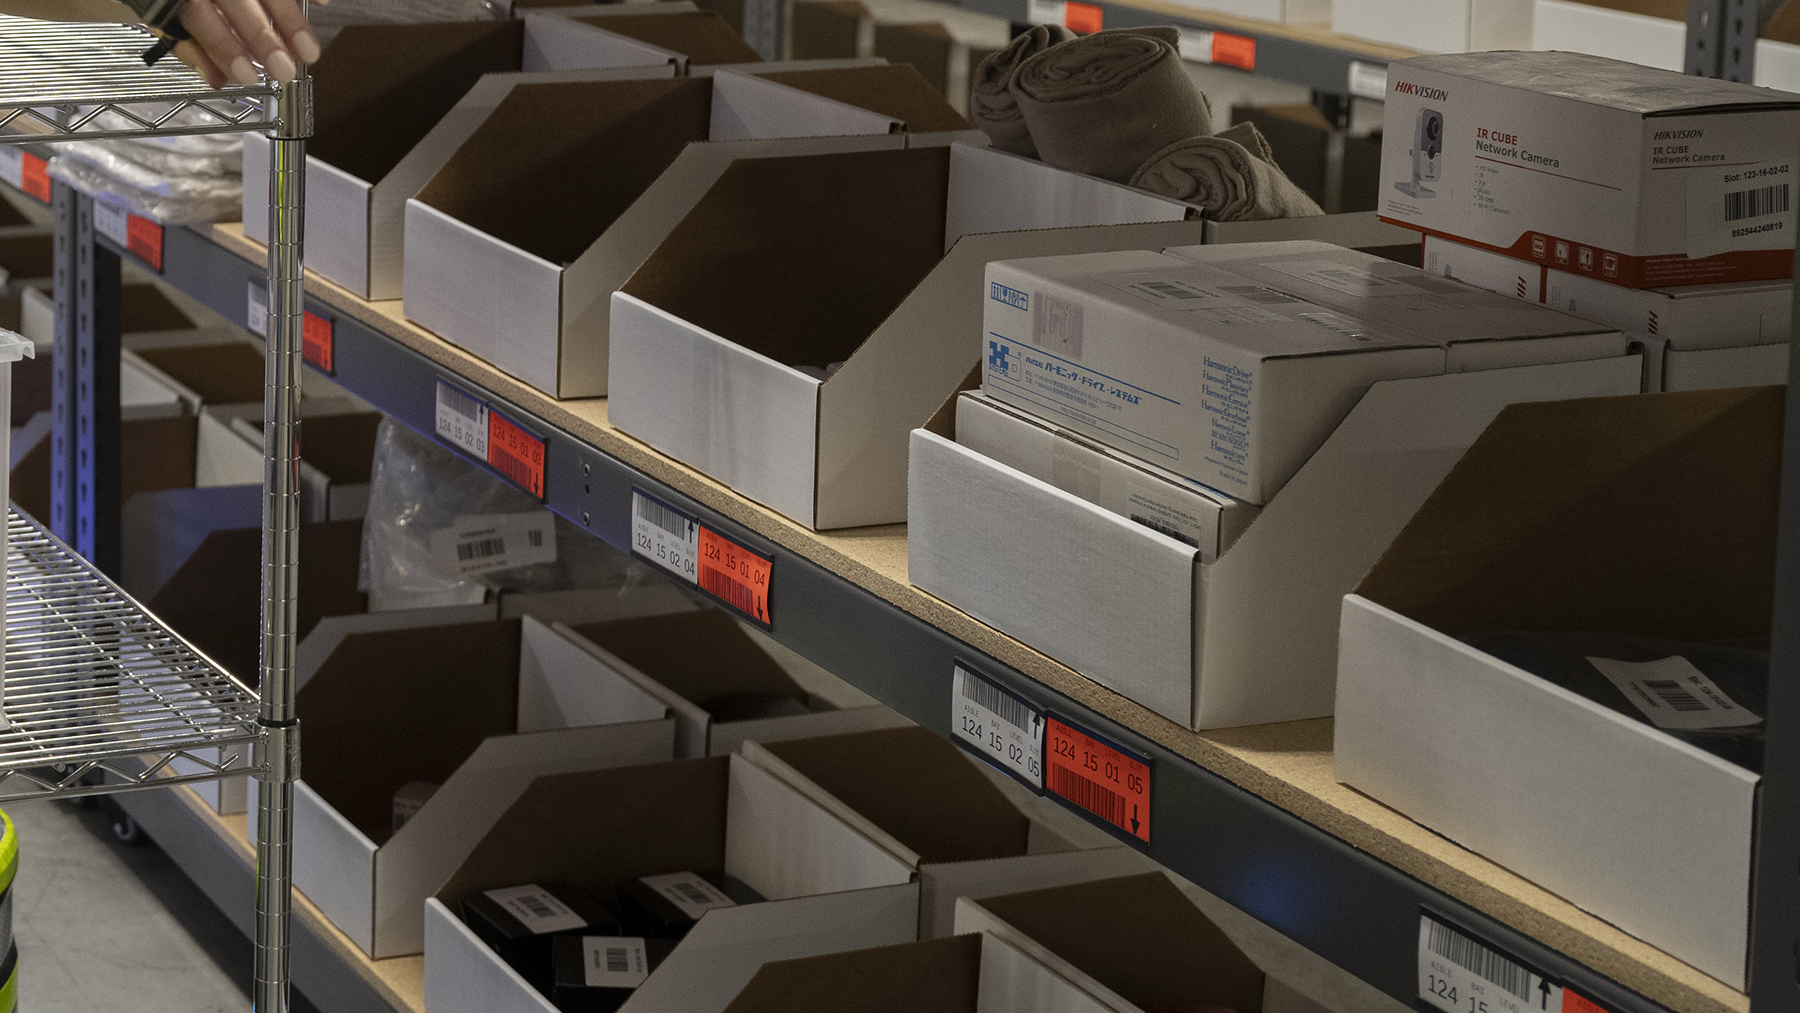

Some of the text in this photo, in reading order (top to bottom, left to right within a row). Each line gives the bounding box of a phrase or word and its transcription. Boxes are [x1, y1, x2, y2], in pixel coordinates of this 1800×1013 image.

[1394, 81, 1449, 102] HIKVISION
[1477, 127, 1518, 146] IR CUBE
[1653, 129, 1704, 141] HIKVISION
[1653, 146, 1689, 155] IR CUBE
[1476, 139, 1560, 168] Network Camera
[1652, 153, 1725, 165] Network Camera
[1724, 164, 1789, 183] Slot: 123-16-02-02
[1731, 221, 1783, 238] 892544240819
[440, 417, 484, 453] 124 15 02 03
[493, 424, 505, 441] 124
[509, 434, 517, 449] 15
[521, 442, 528, 458] 01
[637, 533, 695, 575] 124 15 02 04
[704, 543, 765, 587] 124 15 01 04
[964, 704, 979, 718] AISLE
[1009, 731, 1024, 745] LEVEL
[961, 716, 1040, 777] 124 15 02 05
[1055, 724, 1072, 738] AISLE
[1105, 748, 1121, 763] LEVEL
[1129, 760, 1143, 773] SLOT
[1054, 737, 1143, 794] 124 15 01 05
[1428, 974, 1488, 1013] 124 15
[1431, 960, 1452, 978] AISLE
[1471, 981, 1485, 995] BAY
